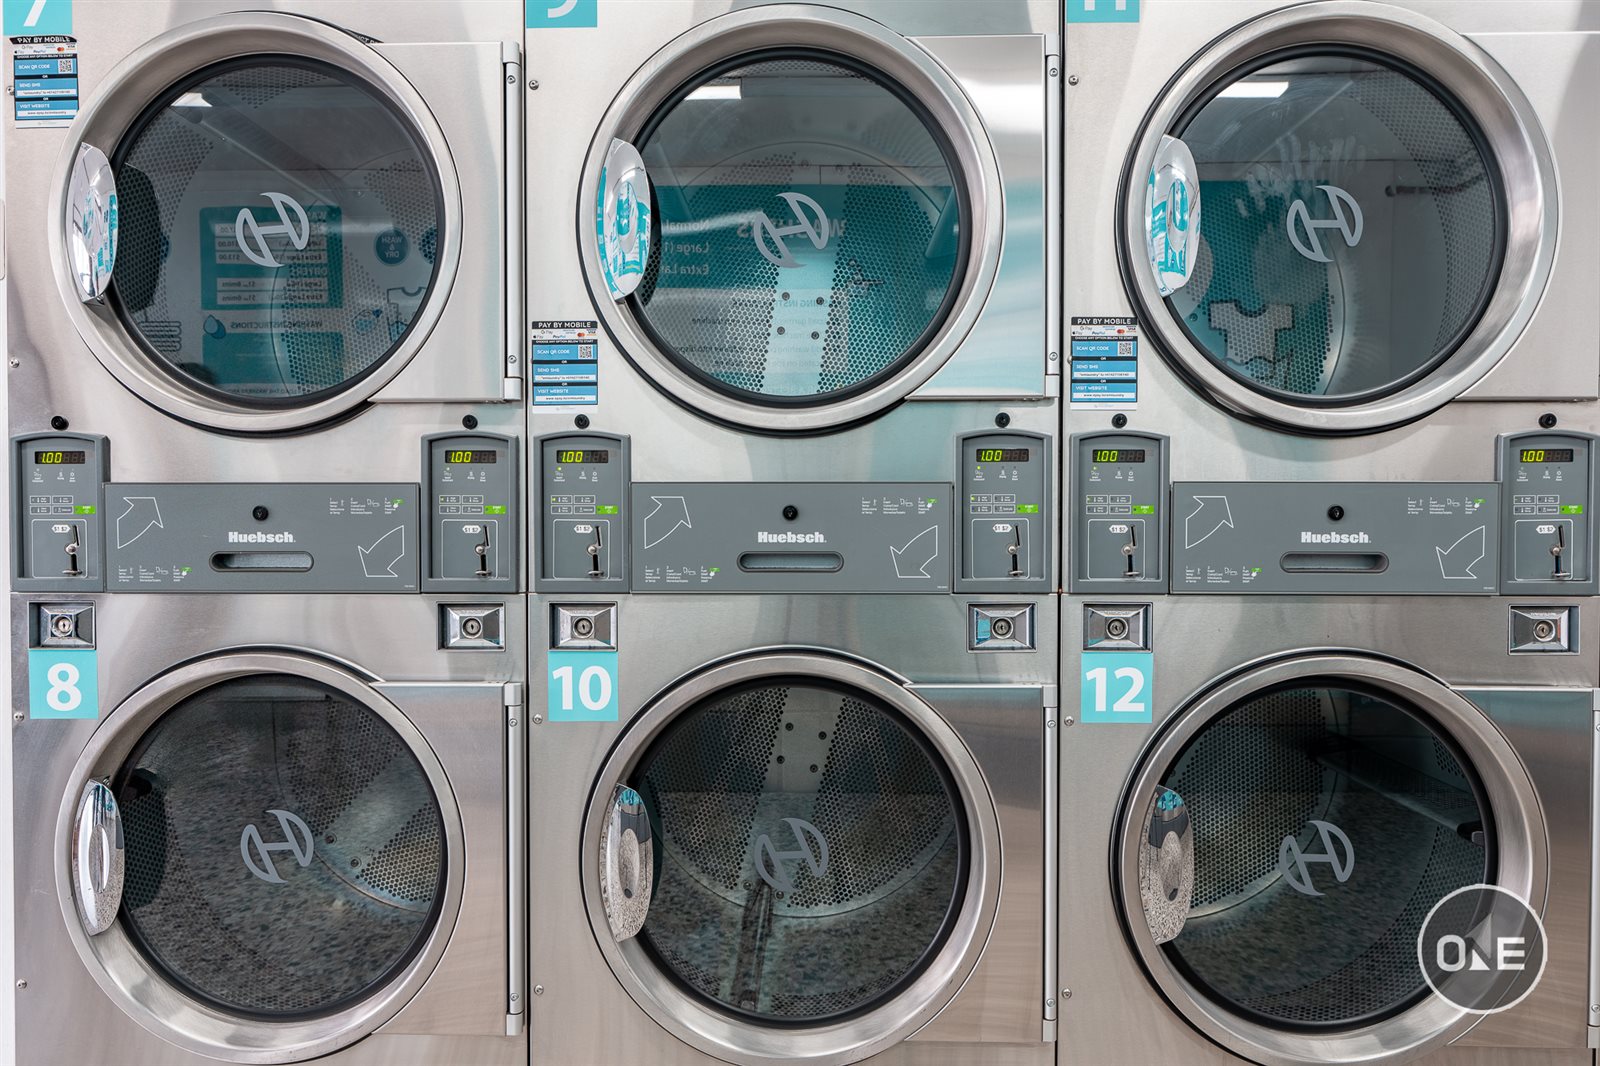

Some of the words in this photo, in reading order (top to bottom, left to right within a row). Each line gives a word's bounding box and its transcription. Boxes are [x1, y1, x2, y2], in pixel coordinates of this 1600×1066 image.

[42, 452, 62, 463] 1.00
[451, 452, 471, 462] 1.00
[562, 452, 583, 462] 1.00
[982, 450, 1002, 461] 1.00
[1097, 451, 1118, 462] 1.00
[1523, 451, 1544, 462] 1.00
[46, 663, 82, 711] 8
[552, 666, 612, 710] 10
[1086, 667, 1145, 712] 12
